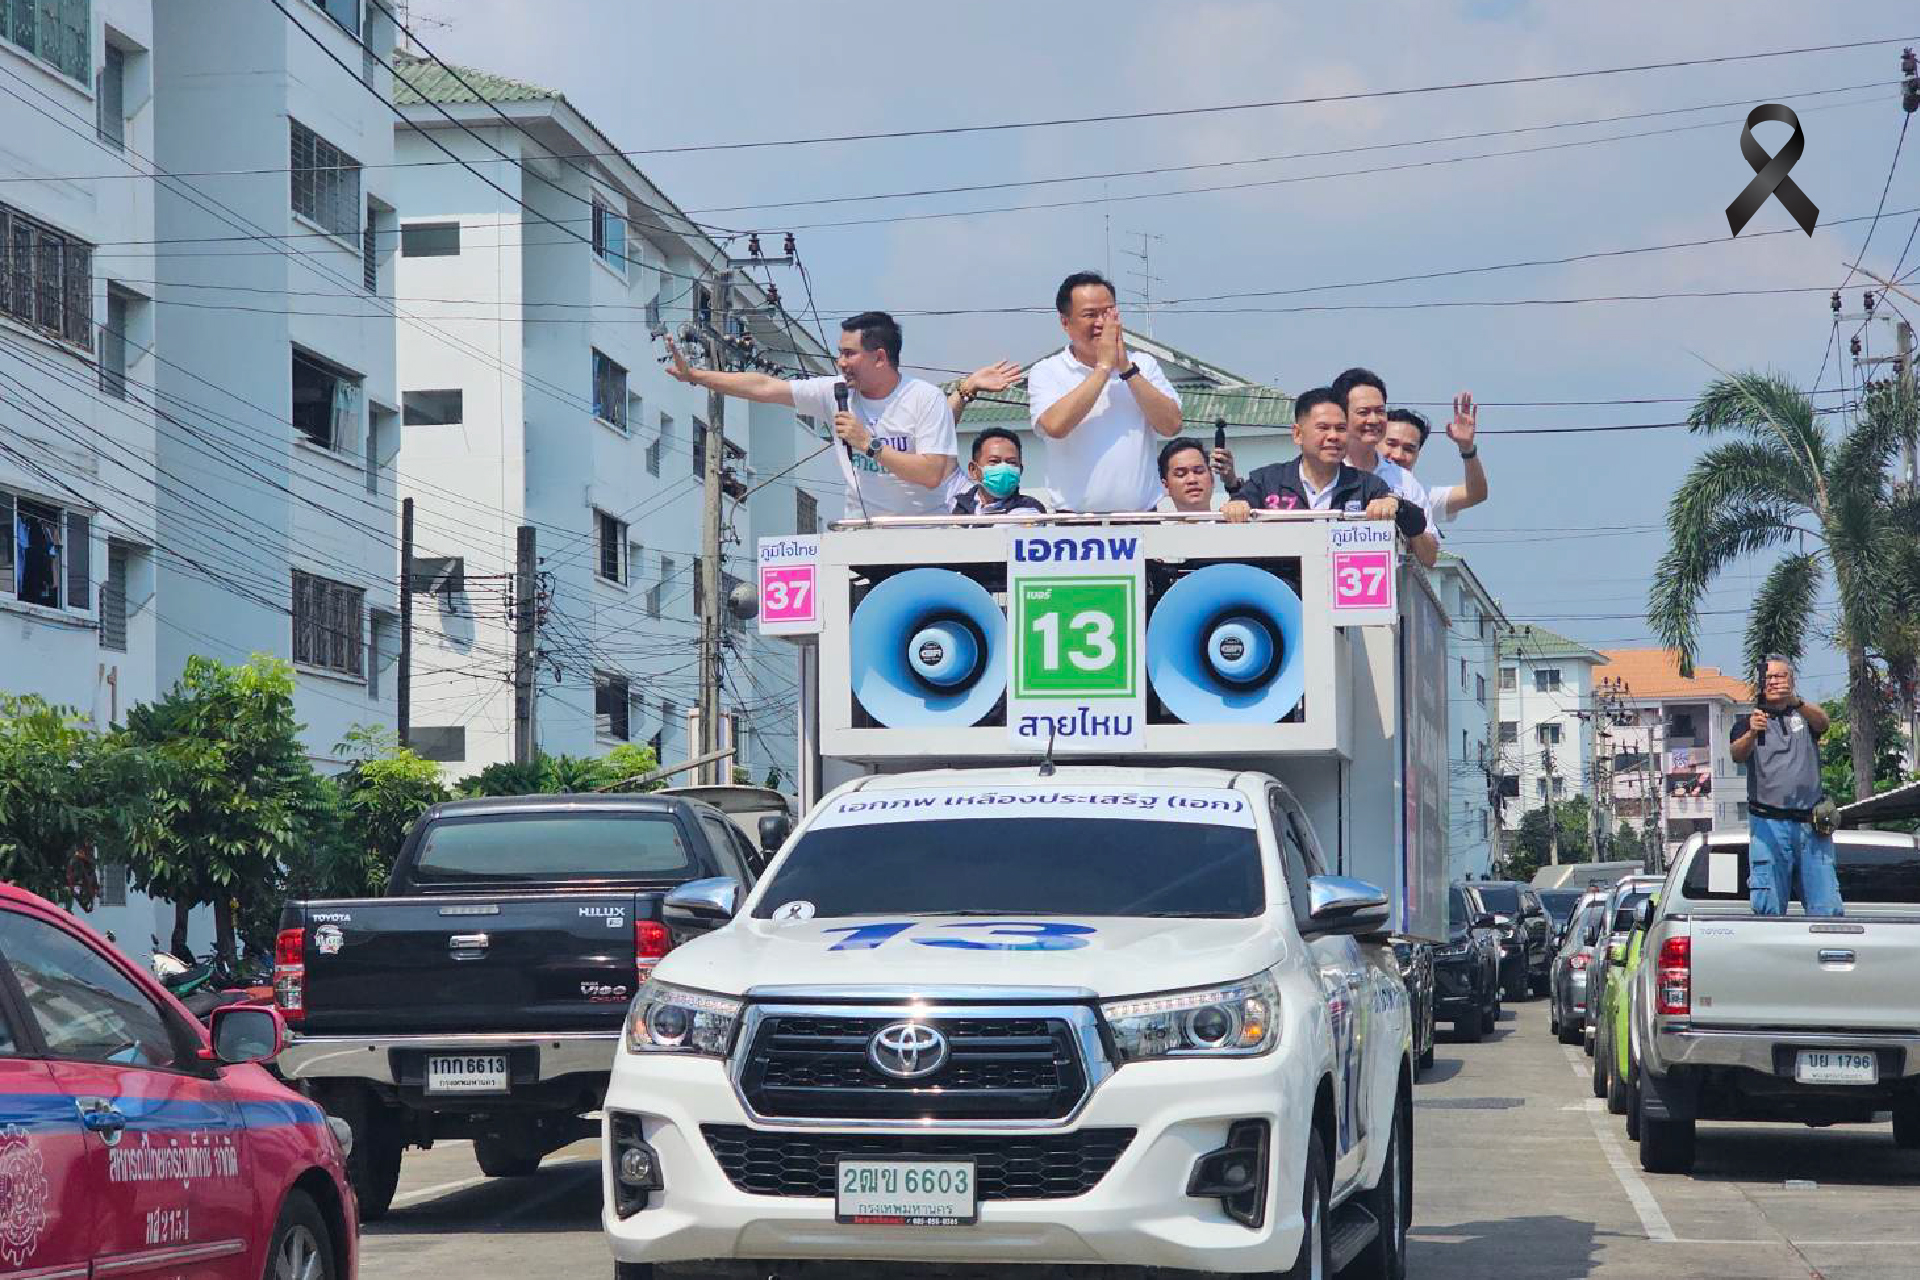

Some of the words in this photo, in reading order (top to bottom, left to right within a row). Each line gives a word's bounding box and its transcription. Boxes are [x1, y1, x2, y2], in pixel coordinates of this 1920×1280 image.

[1331, 526, 1391, 546] ภูมิใจไทย
[761, 541, 817, 561] ภูมิใจไทย
[1015, 537, 1137, 562] เอกภพ
[1339, 567, 1386, 597] 37
[767, 580, 811, 610] 37
[1032, 609, 1116, 671] 13
[1019, 708, 1133, 736] สายไหม
[839, 796, 937, 813] เอกภพ
[945, 792, 1159, 810] เหลืองประเสริฐ
[1167, 796, 1244, 813] (เอก)
[313, 914, 351, 922] TOYOTA
[579, 907, 625, 916] HILUX
[821, 921, 1098, 951] 13
[432, 1059, 463, 1075] 1กก
[467, 1058, 505, 1074] 6613
[1838, 1054, 1869, 1069] 1796
[905, 1168, 969, 1194] 6603
[858, 1203, 954, 1215] กรงเทพมหานคร
